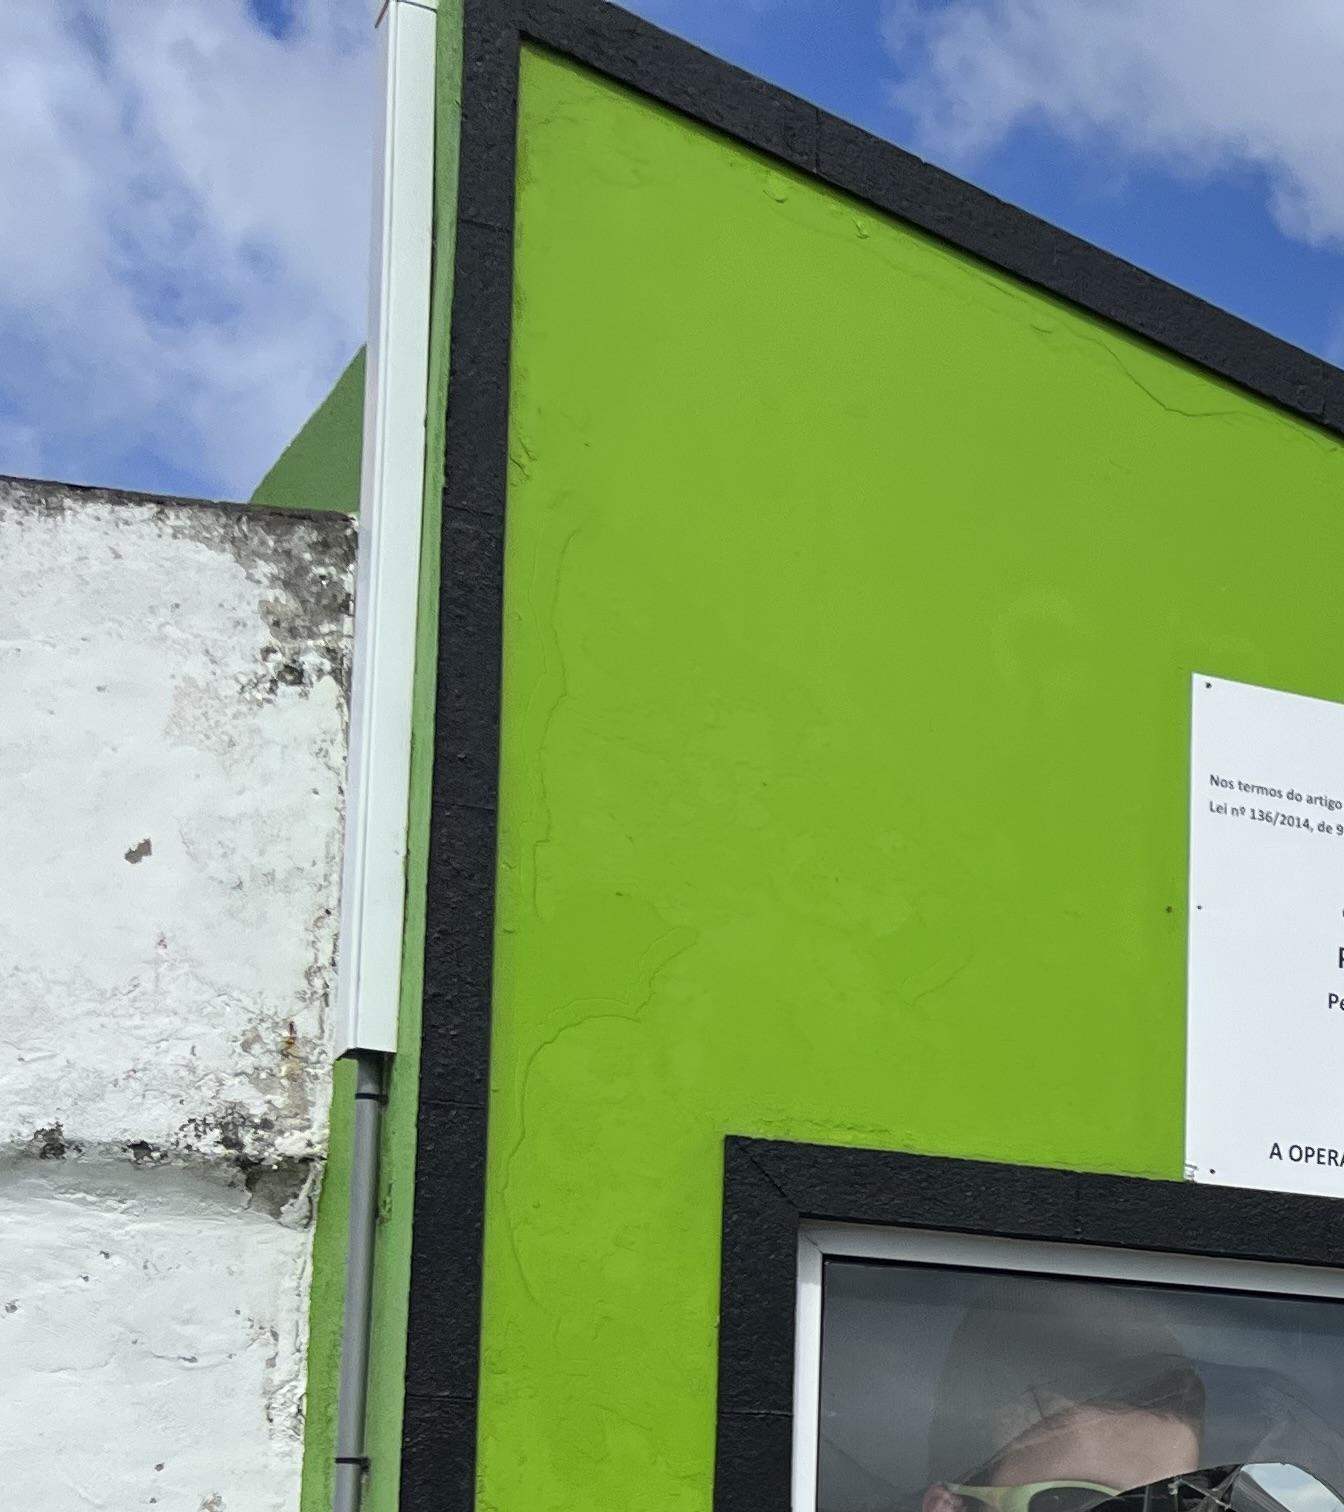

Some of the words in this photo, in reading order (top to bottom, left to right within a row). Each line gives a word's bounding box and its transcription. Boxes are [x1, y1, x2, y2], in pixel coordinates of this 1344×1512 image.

[1209, 773, 1235, 790] Nos
[1237, 780, 1284, 800] termos
[1285, 788, 1303, 803] do
[1305, 794, 1343, 812] artigo
[1209, 800, 1228, 815] Lei
[1250, 807, 1314, 833] 136/2014,
[1317, 820, 1334, 835] de
[1335, 823, 1344, 836] 9
[1268, 1142, 1284, 1161] A
